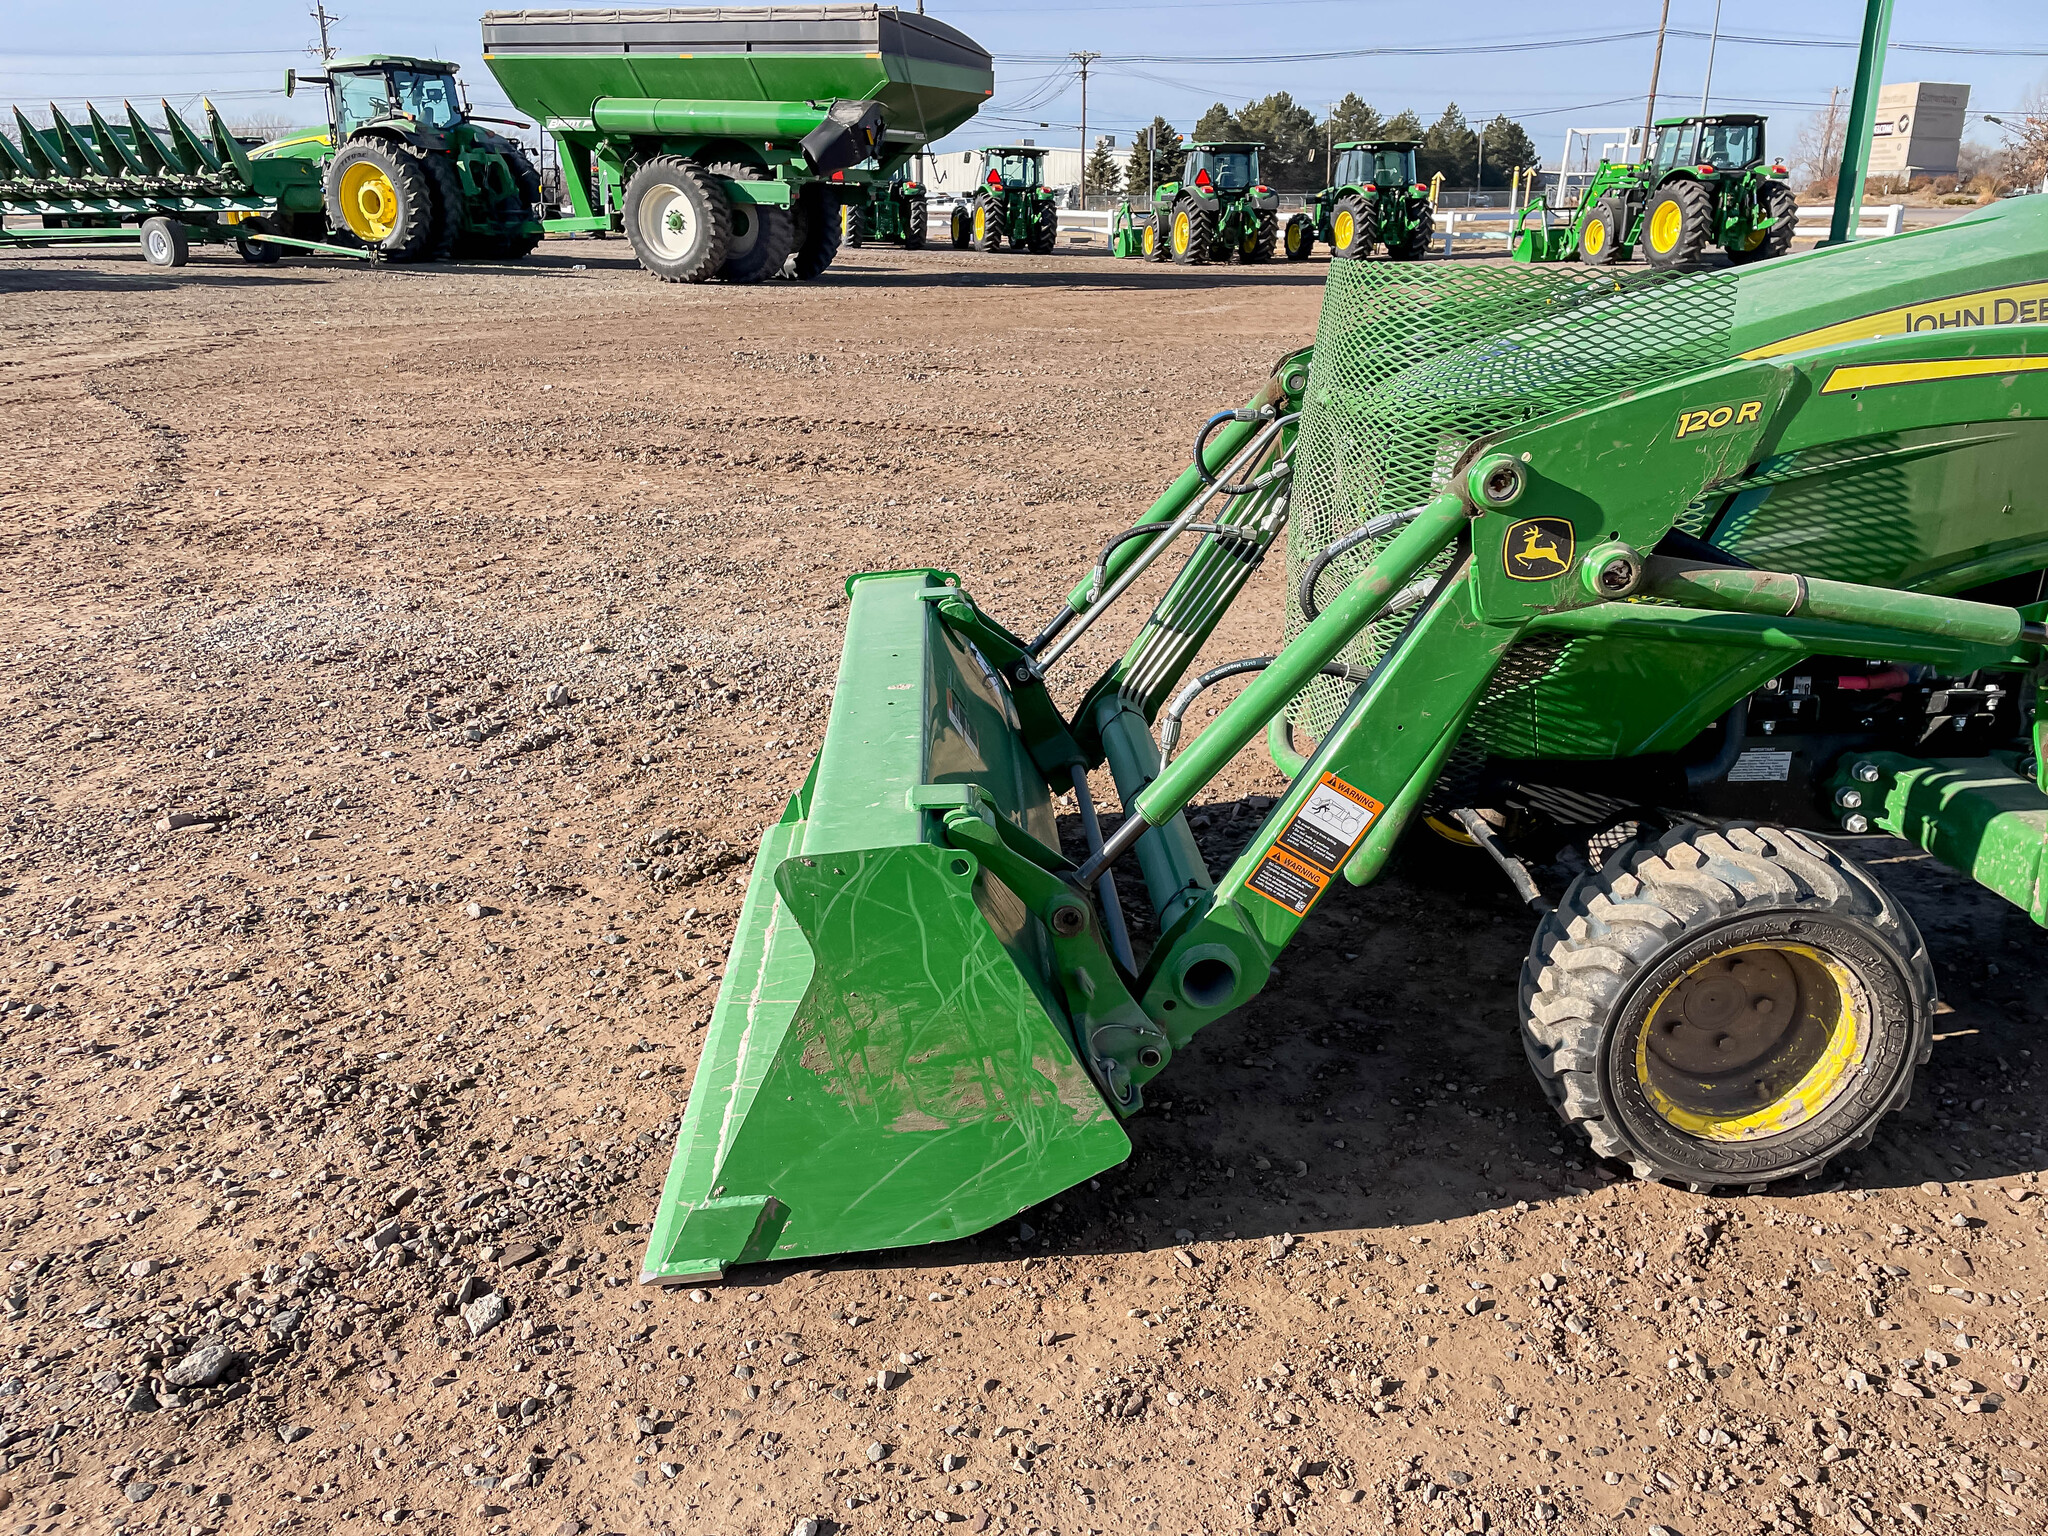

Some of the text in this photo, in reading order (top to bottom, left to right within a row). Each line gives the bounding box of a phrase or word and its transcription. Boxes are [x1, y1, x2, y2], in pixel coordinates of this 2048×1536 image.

[1675, 401, 1763, 439] 120 R
[1337, 783, 1375, 809] WARNING
[1284, 858, 1320, 883] WARNING
